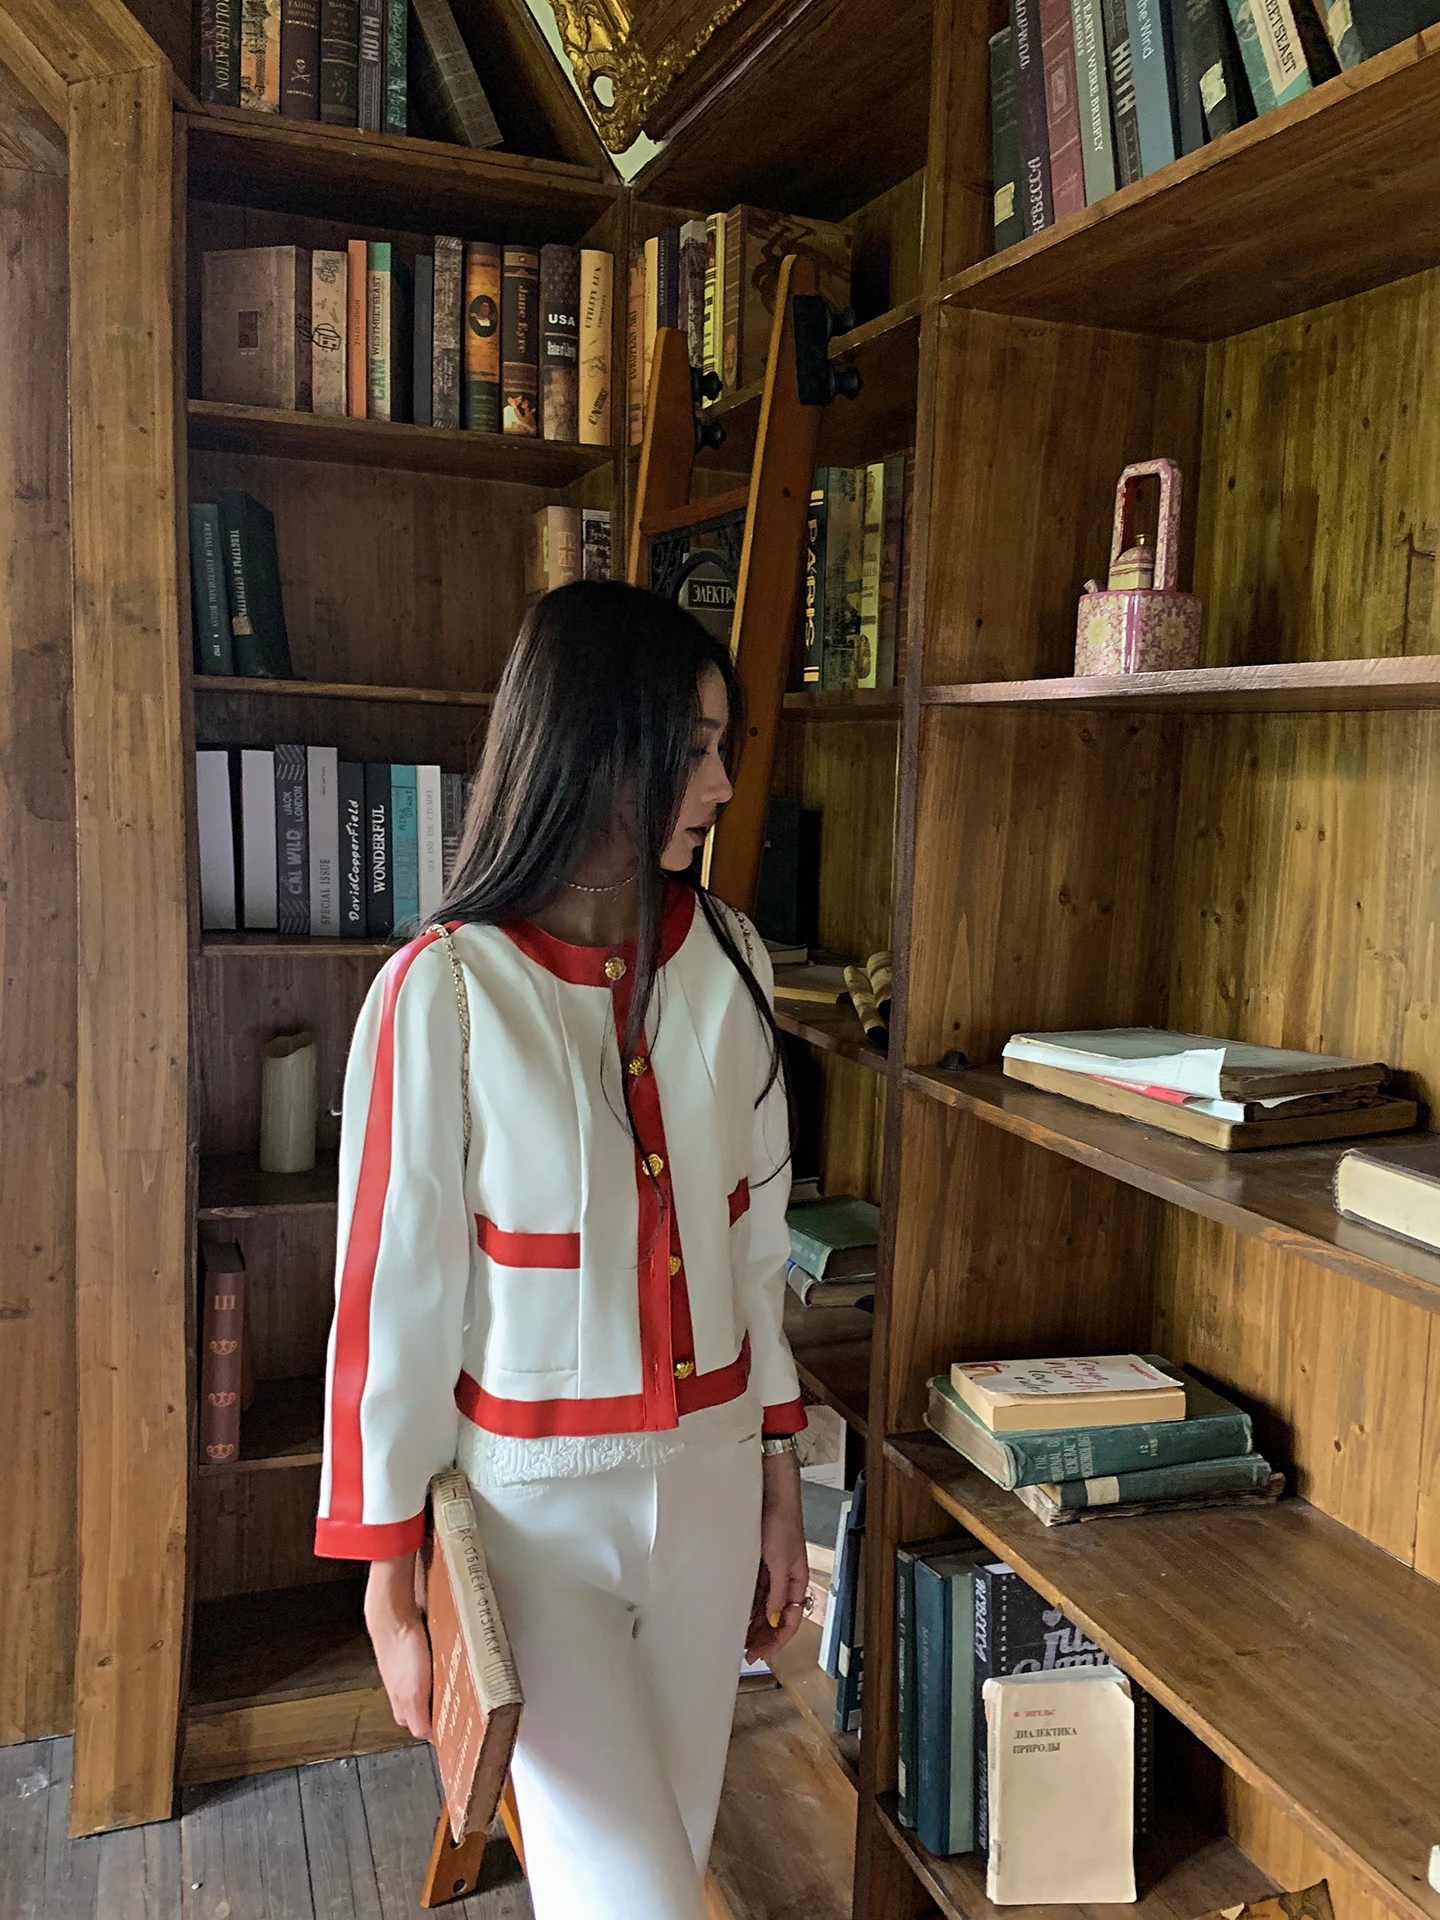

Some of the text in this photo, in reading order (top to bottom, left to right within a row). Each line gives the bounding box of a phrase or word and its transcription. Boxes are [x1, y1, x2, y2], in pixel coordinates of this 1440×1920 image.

[1091, 95, 1104, 151] BRIEFLY
[516, 284, 529, 354] Jane Eyre
[548, 313, 576, 327] USA
[805, 518, 819, 648] PARIS
[282, 791, 292, 816] JACK
[293, 785, 304, 822] LONDON
[286, 829, 303, 866] WILD
[426, 823, 434, 837] THE
[427, 841, 435, 855] AND
[372, 804, 385, 894] WONDERFUL
[427, 859, 435, 874] SEX
[319, 858, 331, 925] SPECIAL ISSUE
[1063, 1442, 1079, 1475] GENERAL
[459, 1526, 502, 1657] РС ОБЩЕЙ ФИЗИКИ
[975, 1577, 988, 1664] REBECCA
[1012, 1742, 1061, 1754] ПРИРОДЫ
[1013, 1726, 1078, 1740] ДИАЛЕКТИКА
